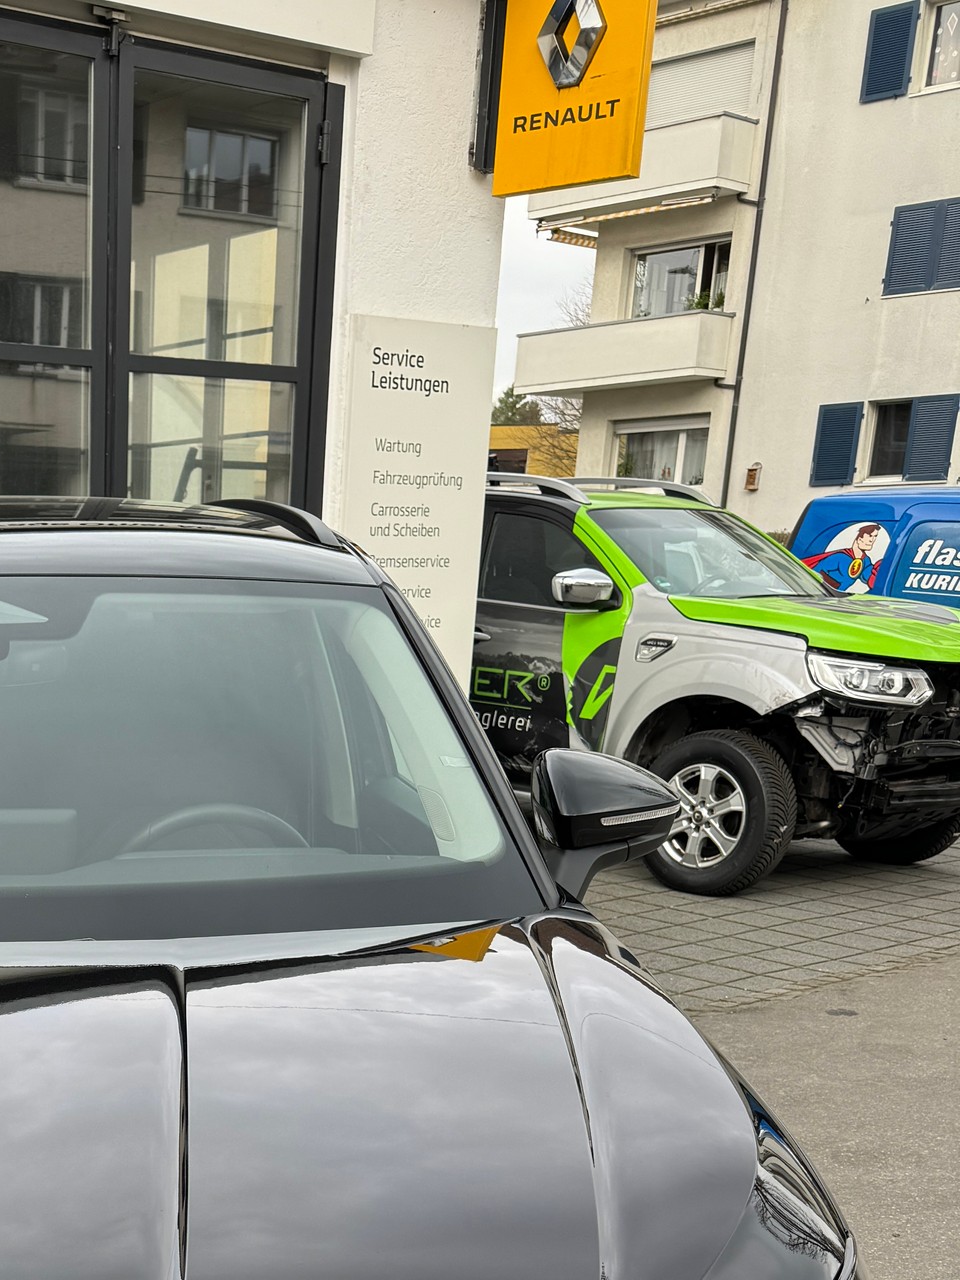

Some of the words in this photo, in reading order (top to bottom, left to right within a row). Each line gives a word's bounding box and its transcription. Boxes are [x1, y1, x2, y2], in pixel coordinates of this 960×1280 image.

[512, 98, 621, 134] RENAULT
[372, 346, 425, 369] Service
[371, 370, 450, 397] Leistungen
[375, 437, 422, 458] Wartung
[372, 470, 463, 491] Fahrzeugprüfung
[370, 502, 430, 518] Carrosserie
[369, 523, 390, 537] und
[392, 523, 440, 538] Scheiben
